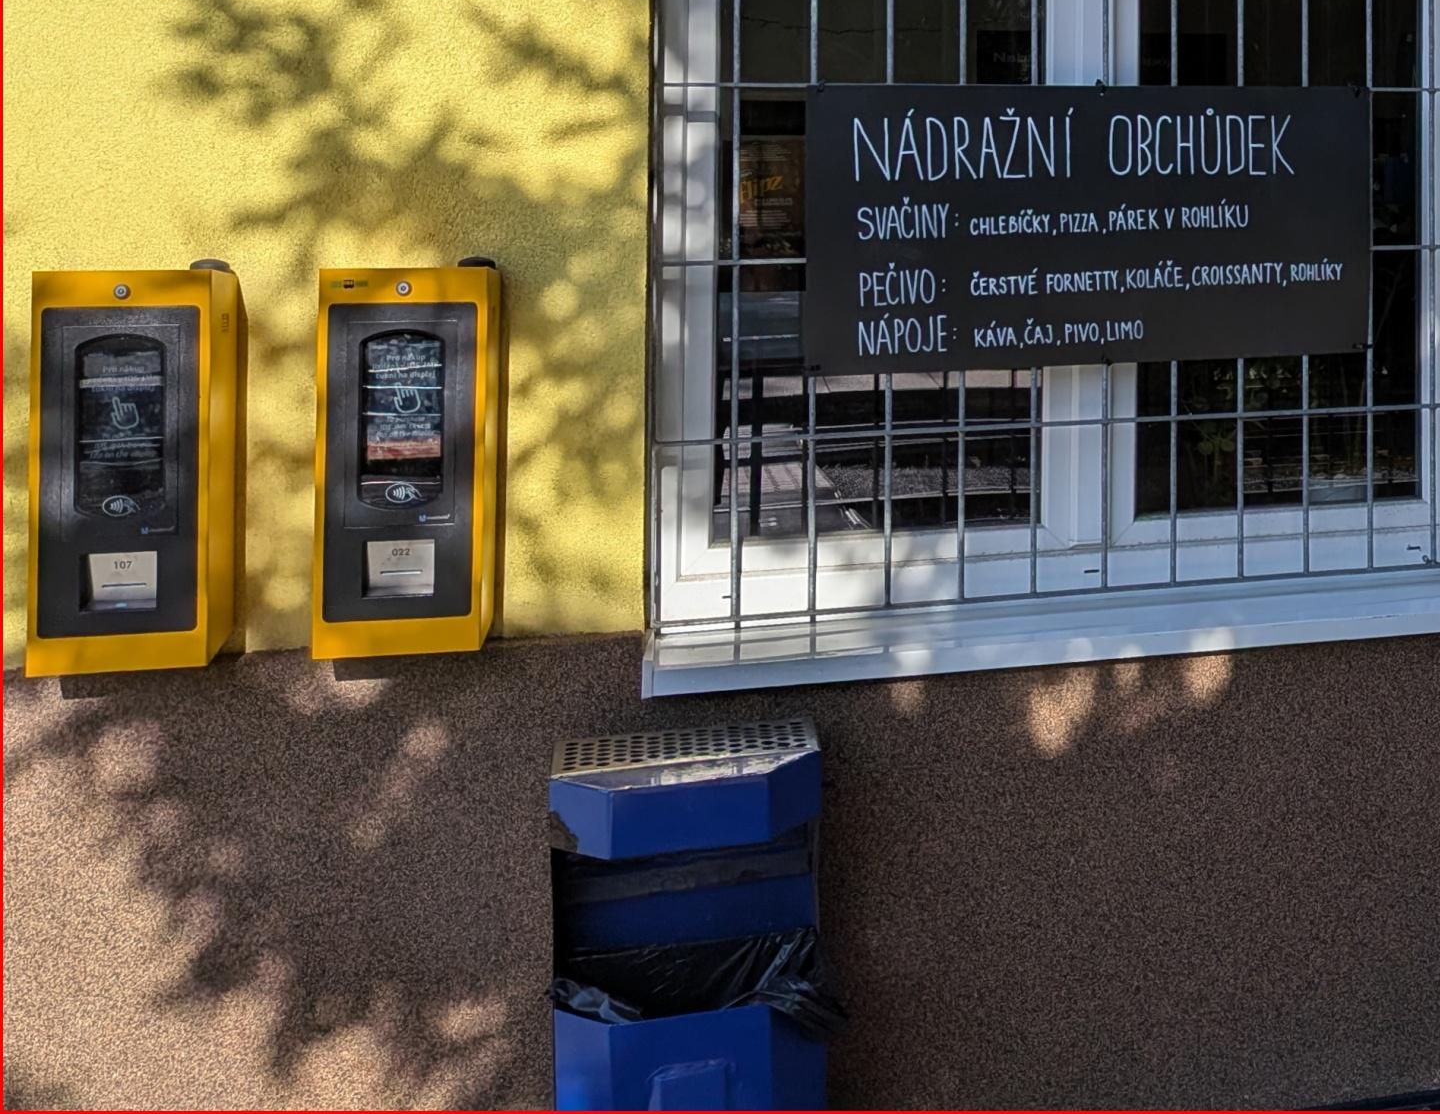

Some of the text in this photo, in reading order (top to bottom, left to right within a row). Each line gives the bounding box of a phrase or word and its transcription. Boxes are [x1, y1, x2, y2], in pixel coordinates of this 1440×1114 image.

[854, 107, 1295, 182] NÁDRAŽNÍ OBCHŮDEK
[857, 197, 960, 240] SVAČINY:
[1109, 203, 1159, 232] PÁREK
[1165, 207, 1175, 230] V
[1181, 198, 1249, 229] ROHLÍKU
[859, 262, 946, 307] PEČIVO:
[970, 267, 1038, 296] ČERSTVÉ
[1290, 258, 1343, 282] ROHLÍKY
[858, 313, 957, 356] NÁPOJE:
[1106, 319, 1144, 341] LIMO
[113, 560, 133, 570] 107
[391, 547, 411, 557] 022
